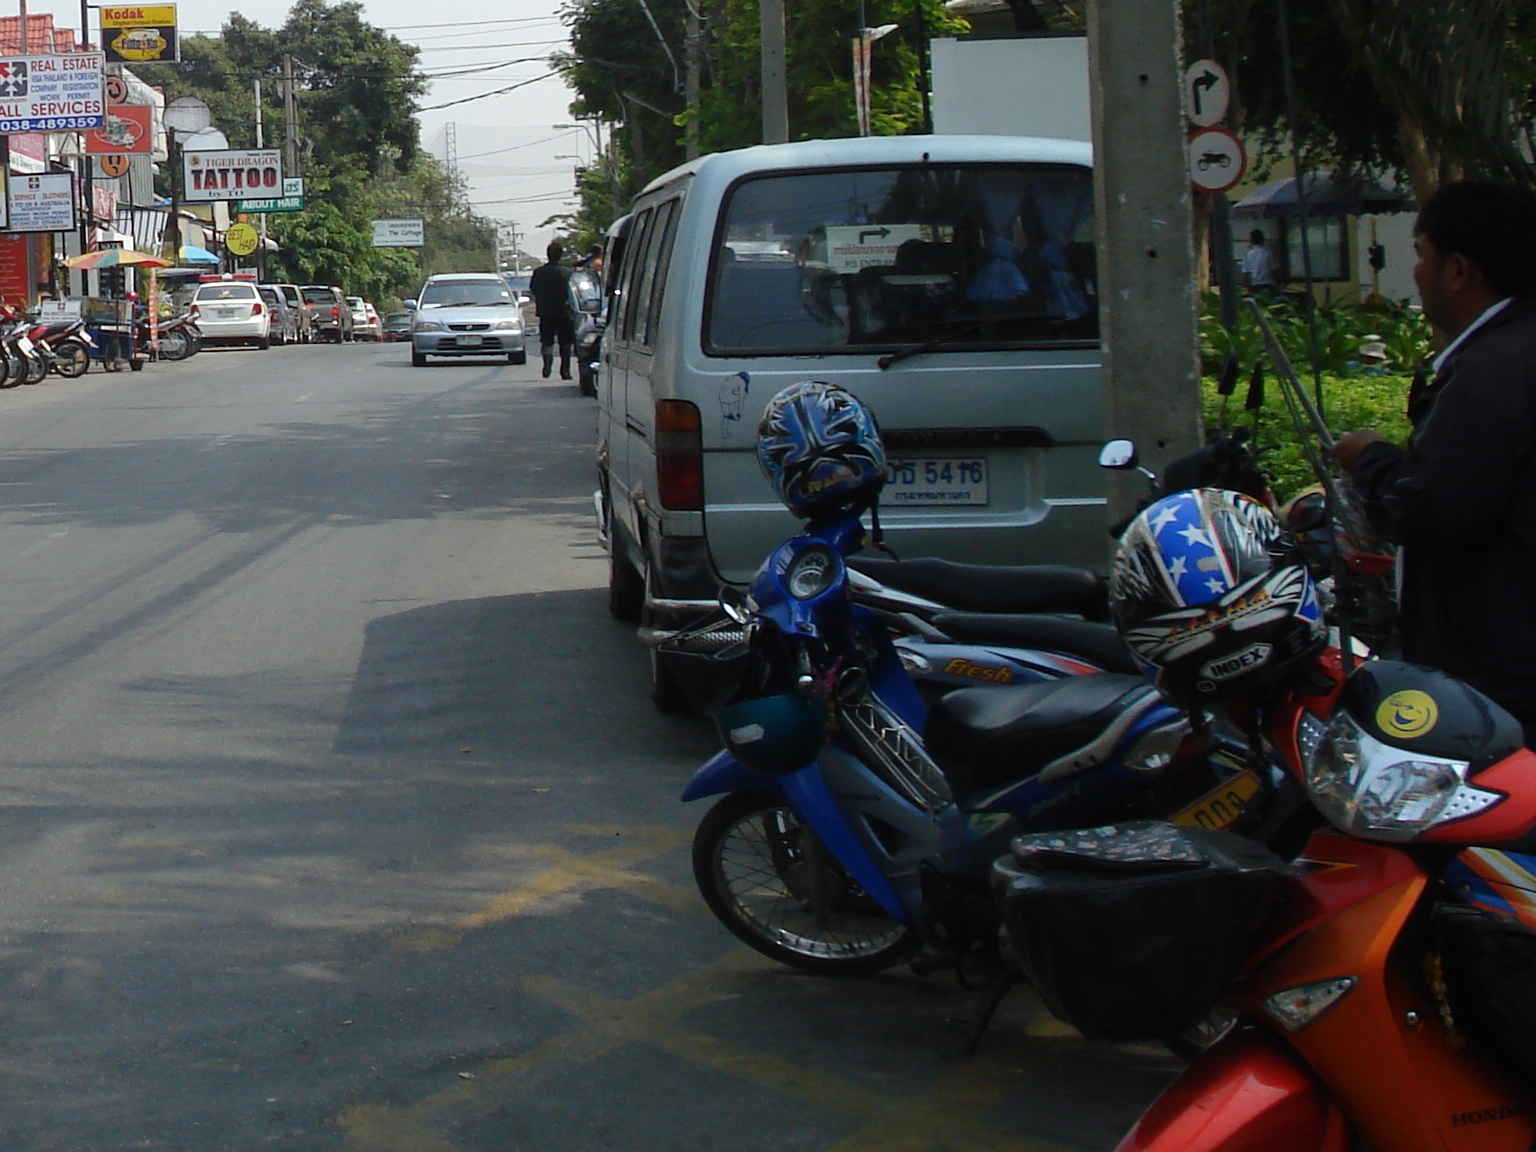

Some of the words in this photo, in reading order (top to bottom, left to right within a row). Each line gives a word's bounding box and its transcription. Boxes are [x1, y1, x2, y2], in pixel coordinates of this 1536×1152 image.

[105, 8, 144, 20] Kodak
[30, 59, 57, 72] REAL
[63, 57, 98, 70] ESTATE
[44, 73, 68, 82] THAILAND
[75, 72, 98, 80] FOREIGN
[30, 84, 57, 93] COMPANY
[63, 82, 98, 91] REGISTRATION
[67, 92, 90, 100] PERMIT
[30, 101, 101, 116] SERVICES
[0, 117, 97, 131] 038-489359
[205, 158, 235, 167] TIGER
[238, 156, 278, 166] DRAGON
[191, 167, 277, 190] TATTOO
[208, 190, 222, 198] by
[242, 199, 274, 209] ABOUT
[277, 197, 300, 208] HAIR
[228, 228, 244, 240] BEST
[925, 461, 983, 485] 5416
[1210, 647, 1264, 678] INDEX
[943, 656, 1014, 685] Fresh
